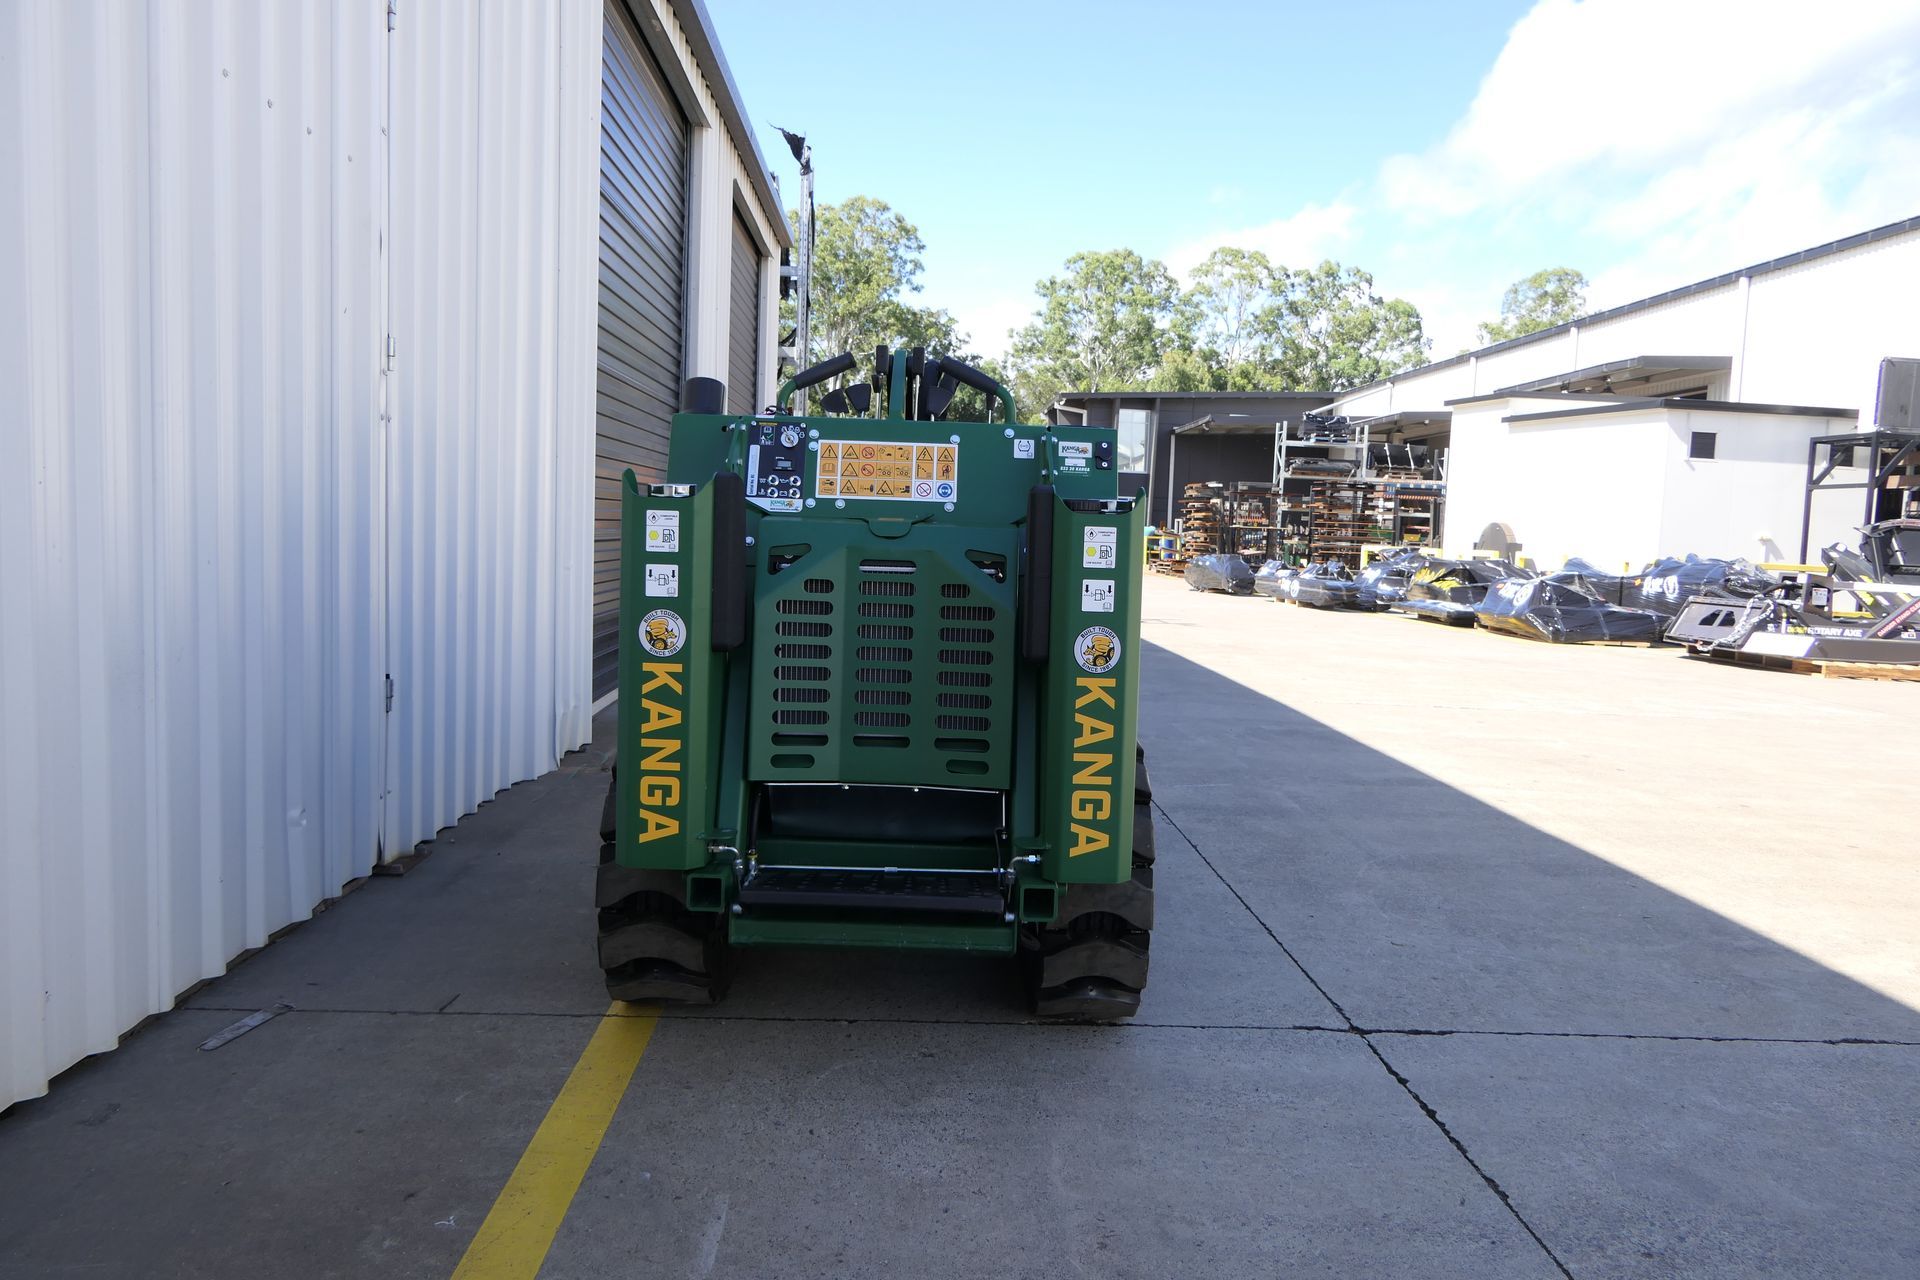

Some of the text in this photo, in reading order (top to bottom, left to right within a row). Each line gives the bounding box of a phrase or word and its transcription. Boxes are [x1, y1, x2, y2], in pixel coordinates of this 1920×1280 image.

[643, 610, 679, 623] BUILT TOUGH
[1080, 627, 1115, 639] BUILT TOUGH
[1807, 626, 1842, 636] ROTARY
[1843, 628, 1863, 638] AXE
[649, 647, 666, 656] SINCE
[1081, 662, 1098, 673] SINCE
[638, 662, 683, 844] KANGA
[1069, 677, 1117, 858] KANGA
